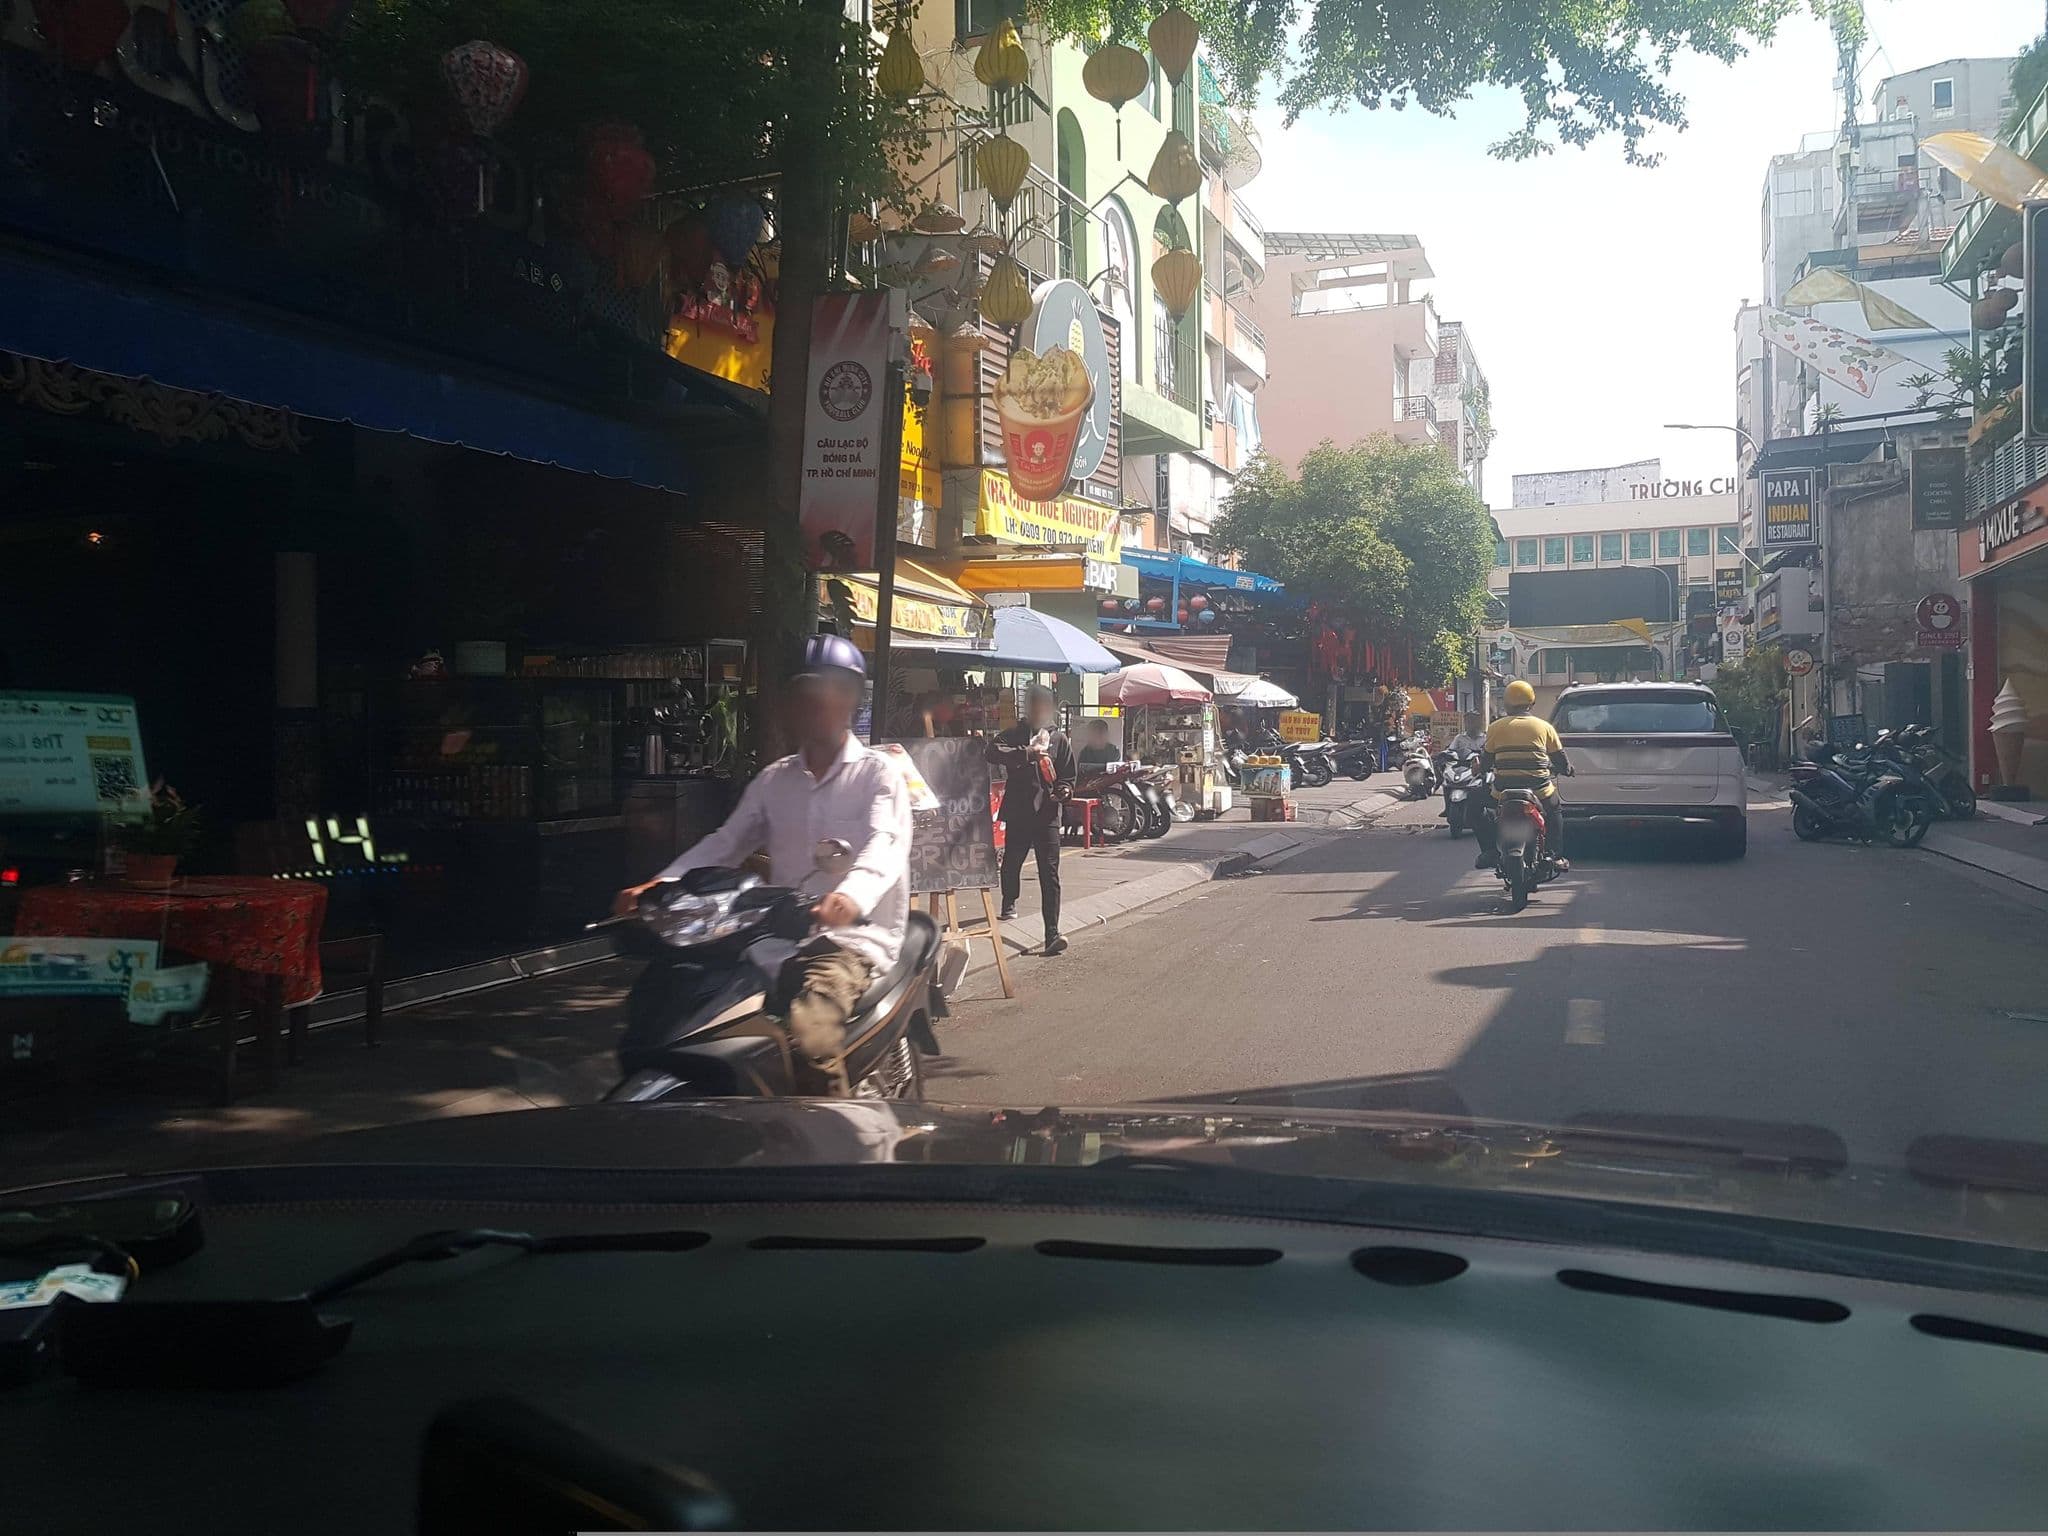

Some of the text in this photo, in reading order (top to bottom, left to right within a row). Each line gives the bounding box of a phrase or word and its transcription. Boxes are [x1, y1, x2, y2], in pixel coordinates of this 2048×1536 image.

[852, 468, 876, 478] MINH
[1629, 478, 1703, 500] TRƯỜNG
[1767, 480, 1801, 498] PAPA
[1767, 504, 1810, 523] INDIAN
[1767, 523, 1810, 540] RESTAURANT
[1986, 500, 2020, 551] MIXUE
[1041, 526, 1058, 545] 700
[306, 817, 376, 866] 14
